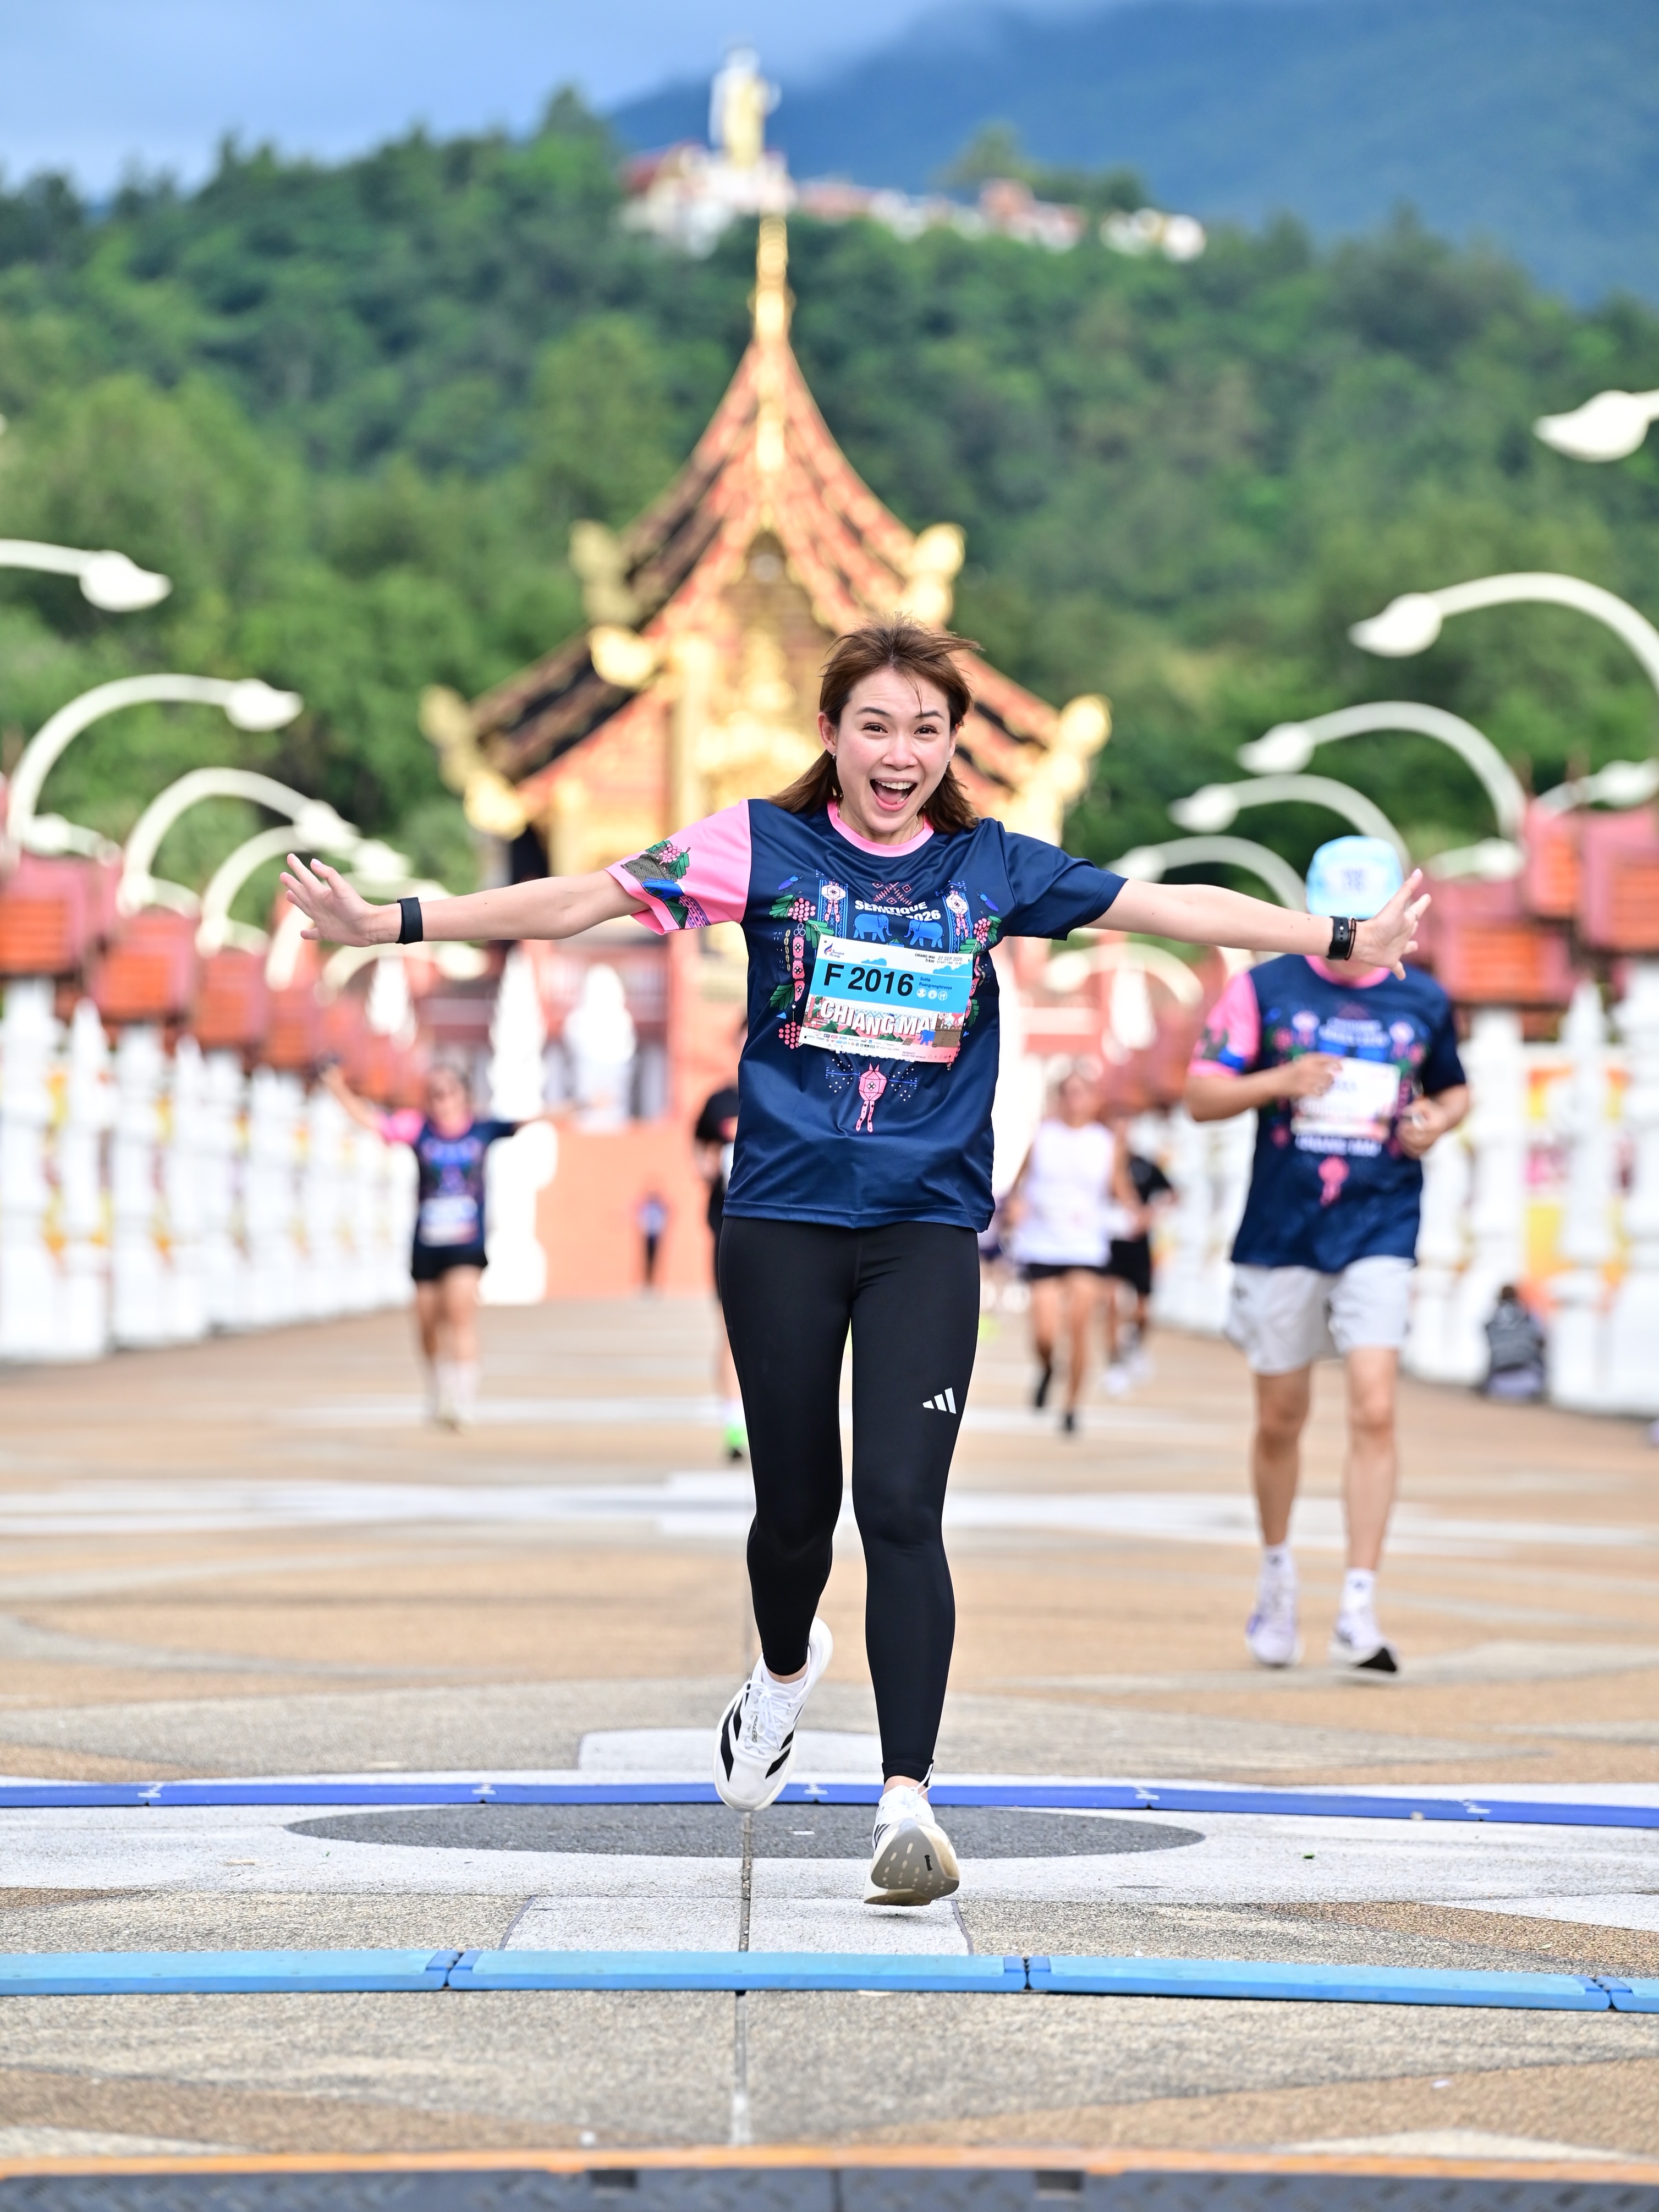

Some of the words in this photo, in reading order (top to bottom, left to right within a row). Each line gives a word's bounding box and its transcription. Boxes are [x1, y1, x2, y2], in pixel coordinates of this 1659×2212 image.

[823, 963, 845, 986] F
[848, 967, 914, 996] 2016
[820, 999, 896, 1036] CHIANG
[897, 1012, 940, 1036] MAI
